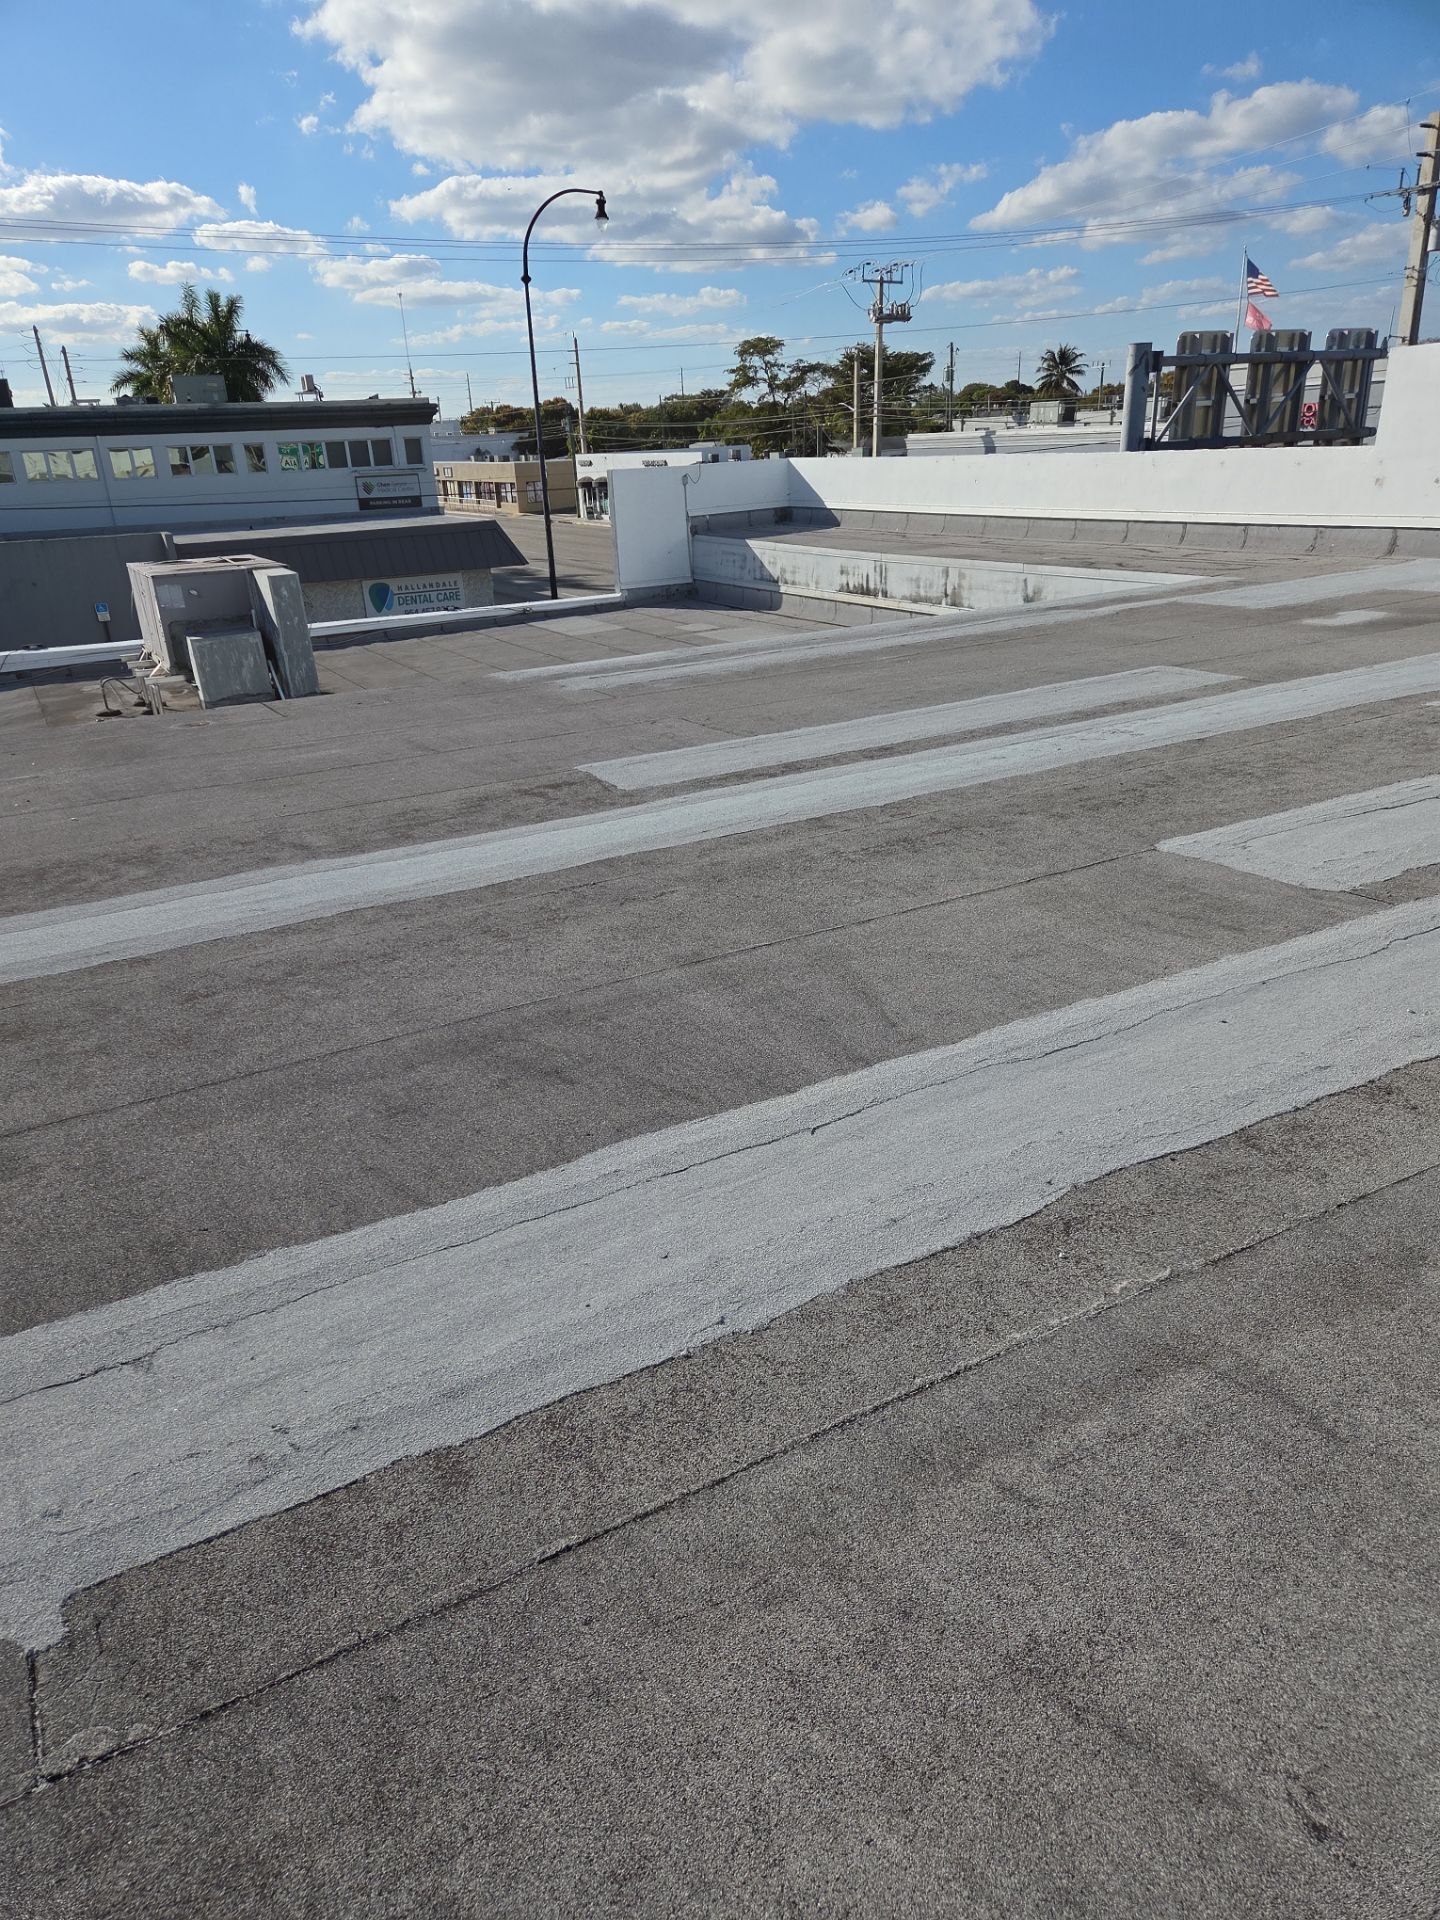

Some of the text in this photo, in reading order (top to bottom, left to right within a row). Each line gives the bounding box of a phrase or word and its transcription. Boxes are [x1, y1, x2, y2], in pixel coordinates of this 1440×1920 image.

[397, 580, 458, 591] HALLANDALE
[397, 591, 461, 606] DENTAL CARE
